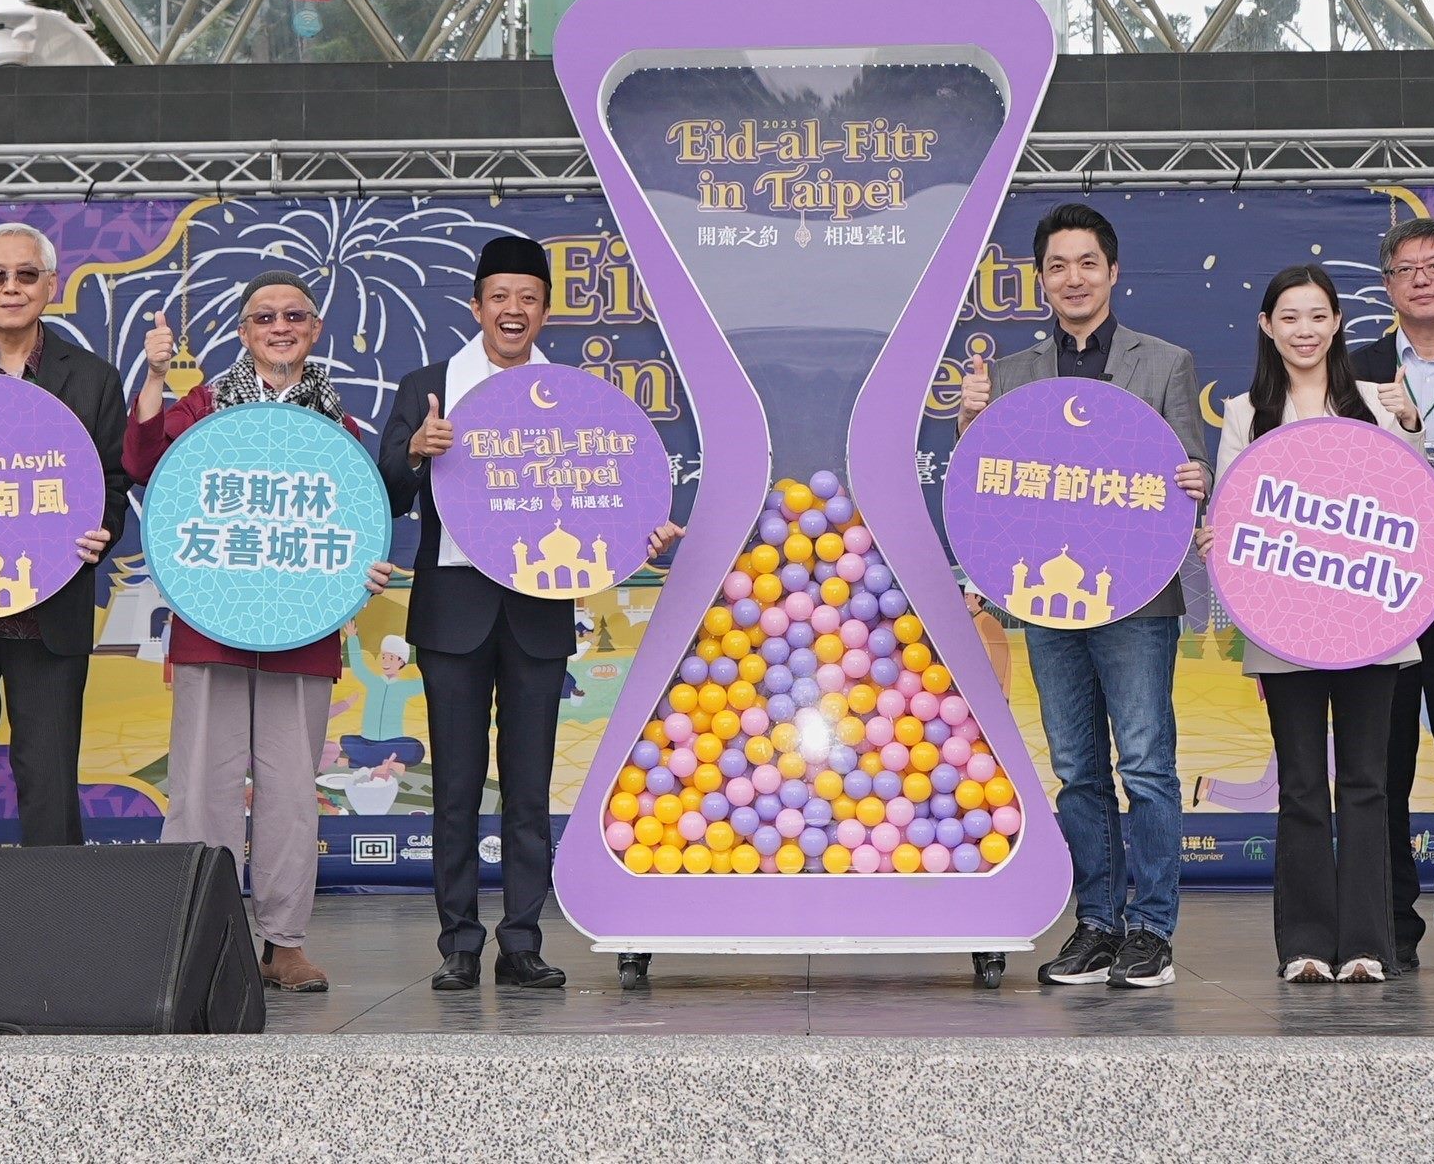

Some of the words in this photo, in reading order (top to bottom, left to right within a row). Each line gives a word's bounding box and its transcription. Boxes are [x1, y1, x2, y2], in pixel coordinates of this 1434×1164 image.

[667, 118, 937, 163] Eid-al-Fitr
[762, 120, 798, 129] 2025
[698, 171, 746, 212] in
[753, 164, 907, 222] Taipei
[698, 225, 779, 248] 開齋之約
[824, 225, 907, 246] 相遇臺北
[10, 450, 66, 473] Asyik
[463, 427, 636, 459] Eid-al-Fitr
[202, 472, 333, 519] 穆斯林
[486, 462, 519, 489] in
[522, 457, 622, 494] Taipei
[975, 457, 1167, 512] 開齋節快樂
[1255, 479, 1416, 549] Muslim
[179, 521, 352, 570] 友善城市
[1232, 527, 1418, 609] Friendly
